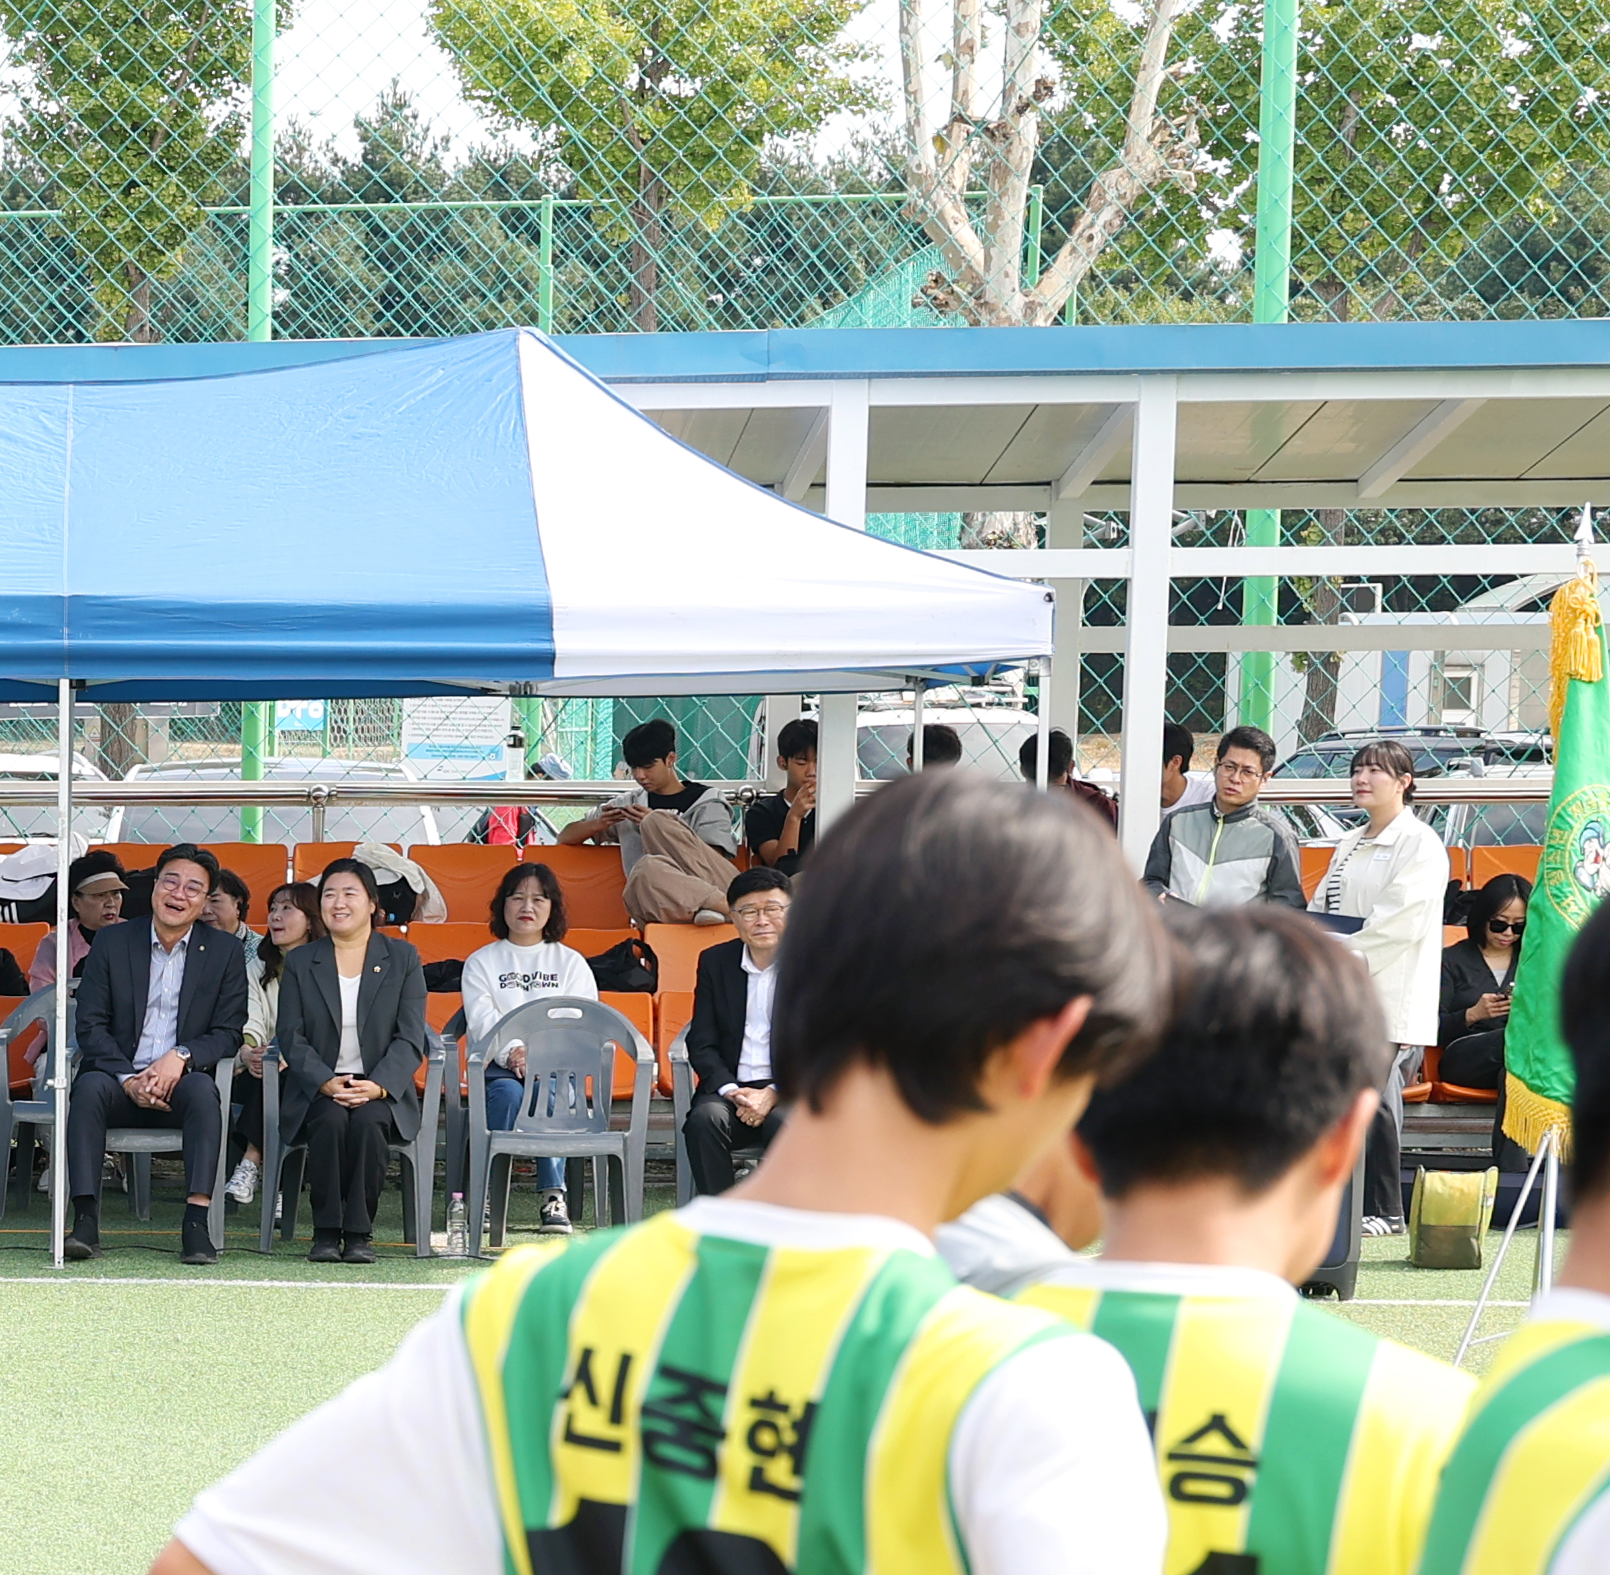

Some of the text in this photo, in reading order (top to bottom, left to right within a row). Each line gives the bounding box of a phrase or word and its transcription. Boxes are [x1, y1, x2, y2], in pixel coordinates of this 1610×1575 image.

[499, 971, 558, 983] GOOD VIBE
[560, 1348, 819, 1503] 신중현
[1147, 1413, 1260, 1507] 승
